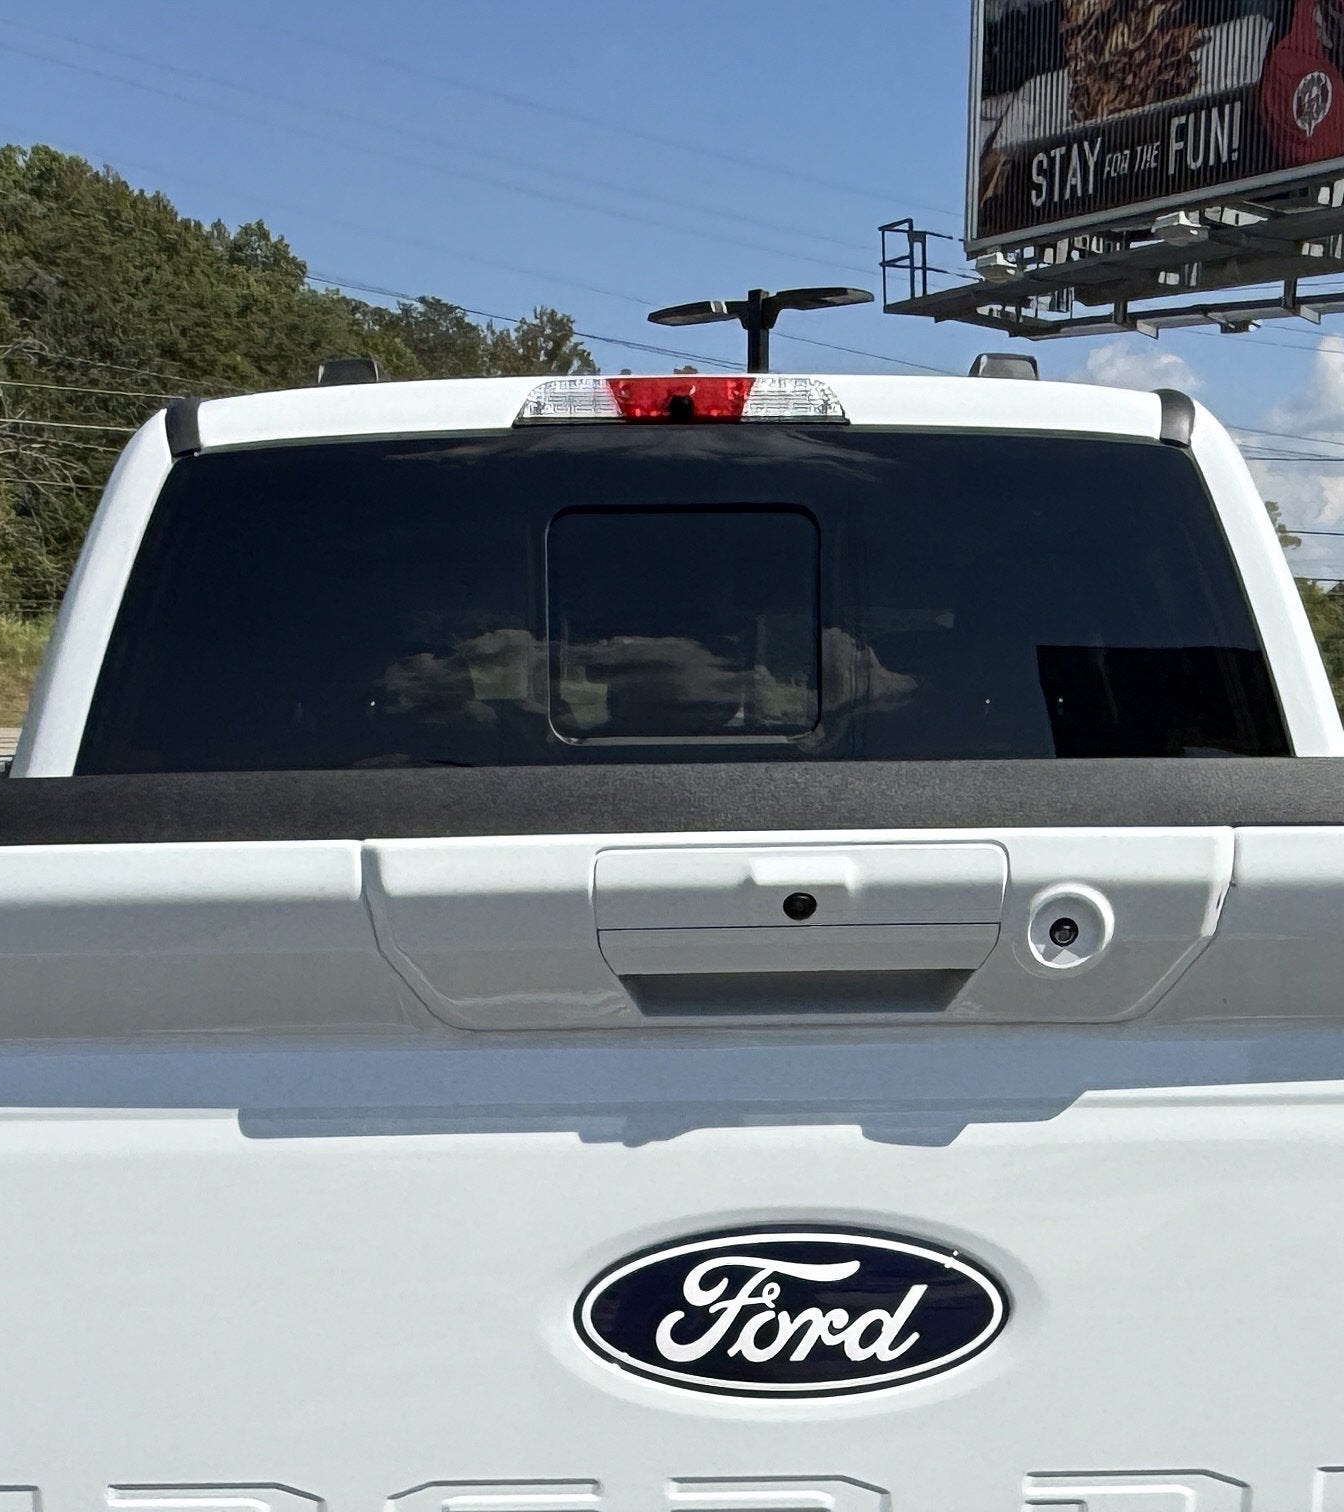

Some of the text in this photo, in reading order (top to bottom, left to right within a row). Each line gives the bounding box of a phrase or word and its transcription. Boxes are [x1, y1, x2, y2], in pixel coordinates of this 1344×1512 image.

[1031, 137, 1102, 207] STAY
[1103, 150, 1129, 180] FOR
[1134, 141, 1161, 173] THE
[1167, 100, 1242, 176] FUN!
[655, 1255, 928, 1363] Ford
